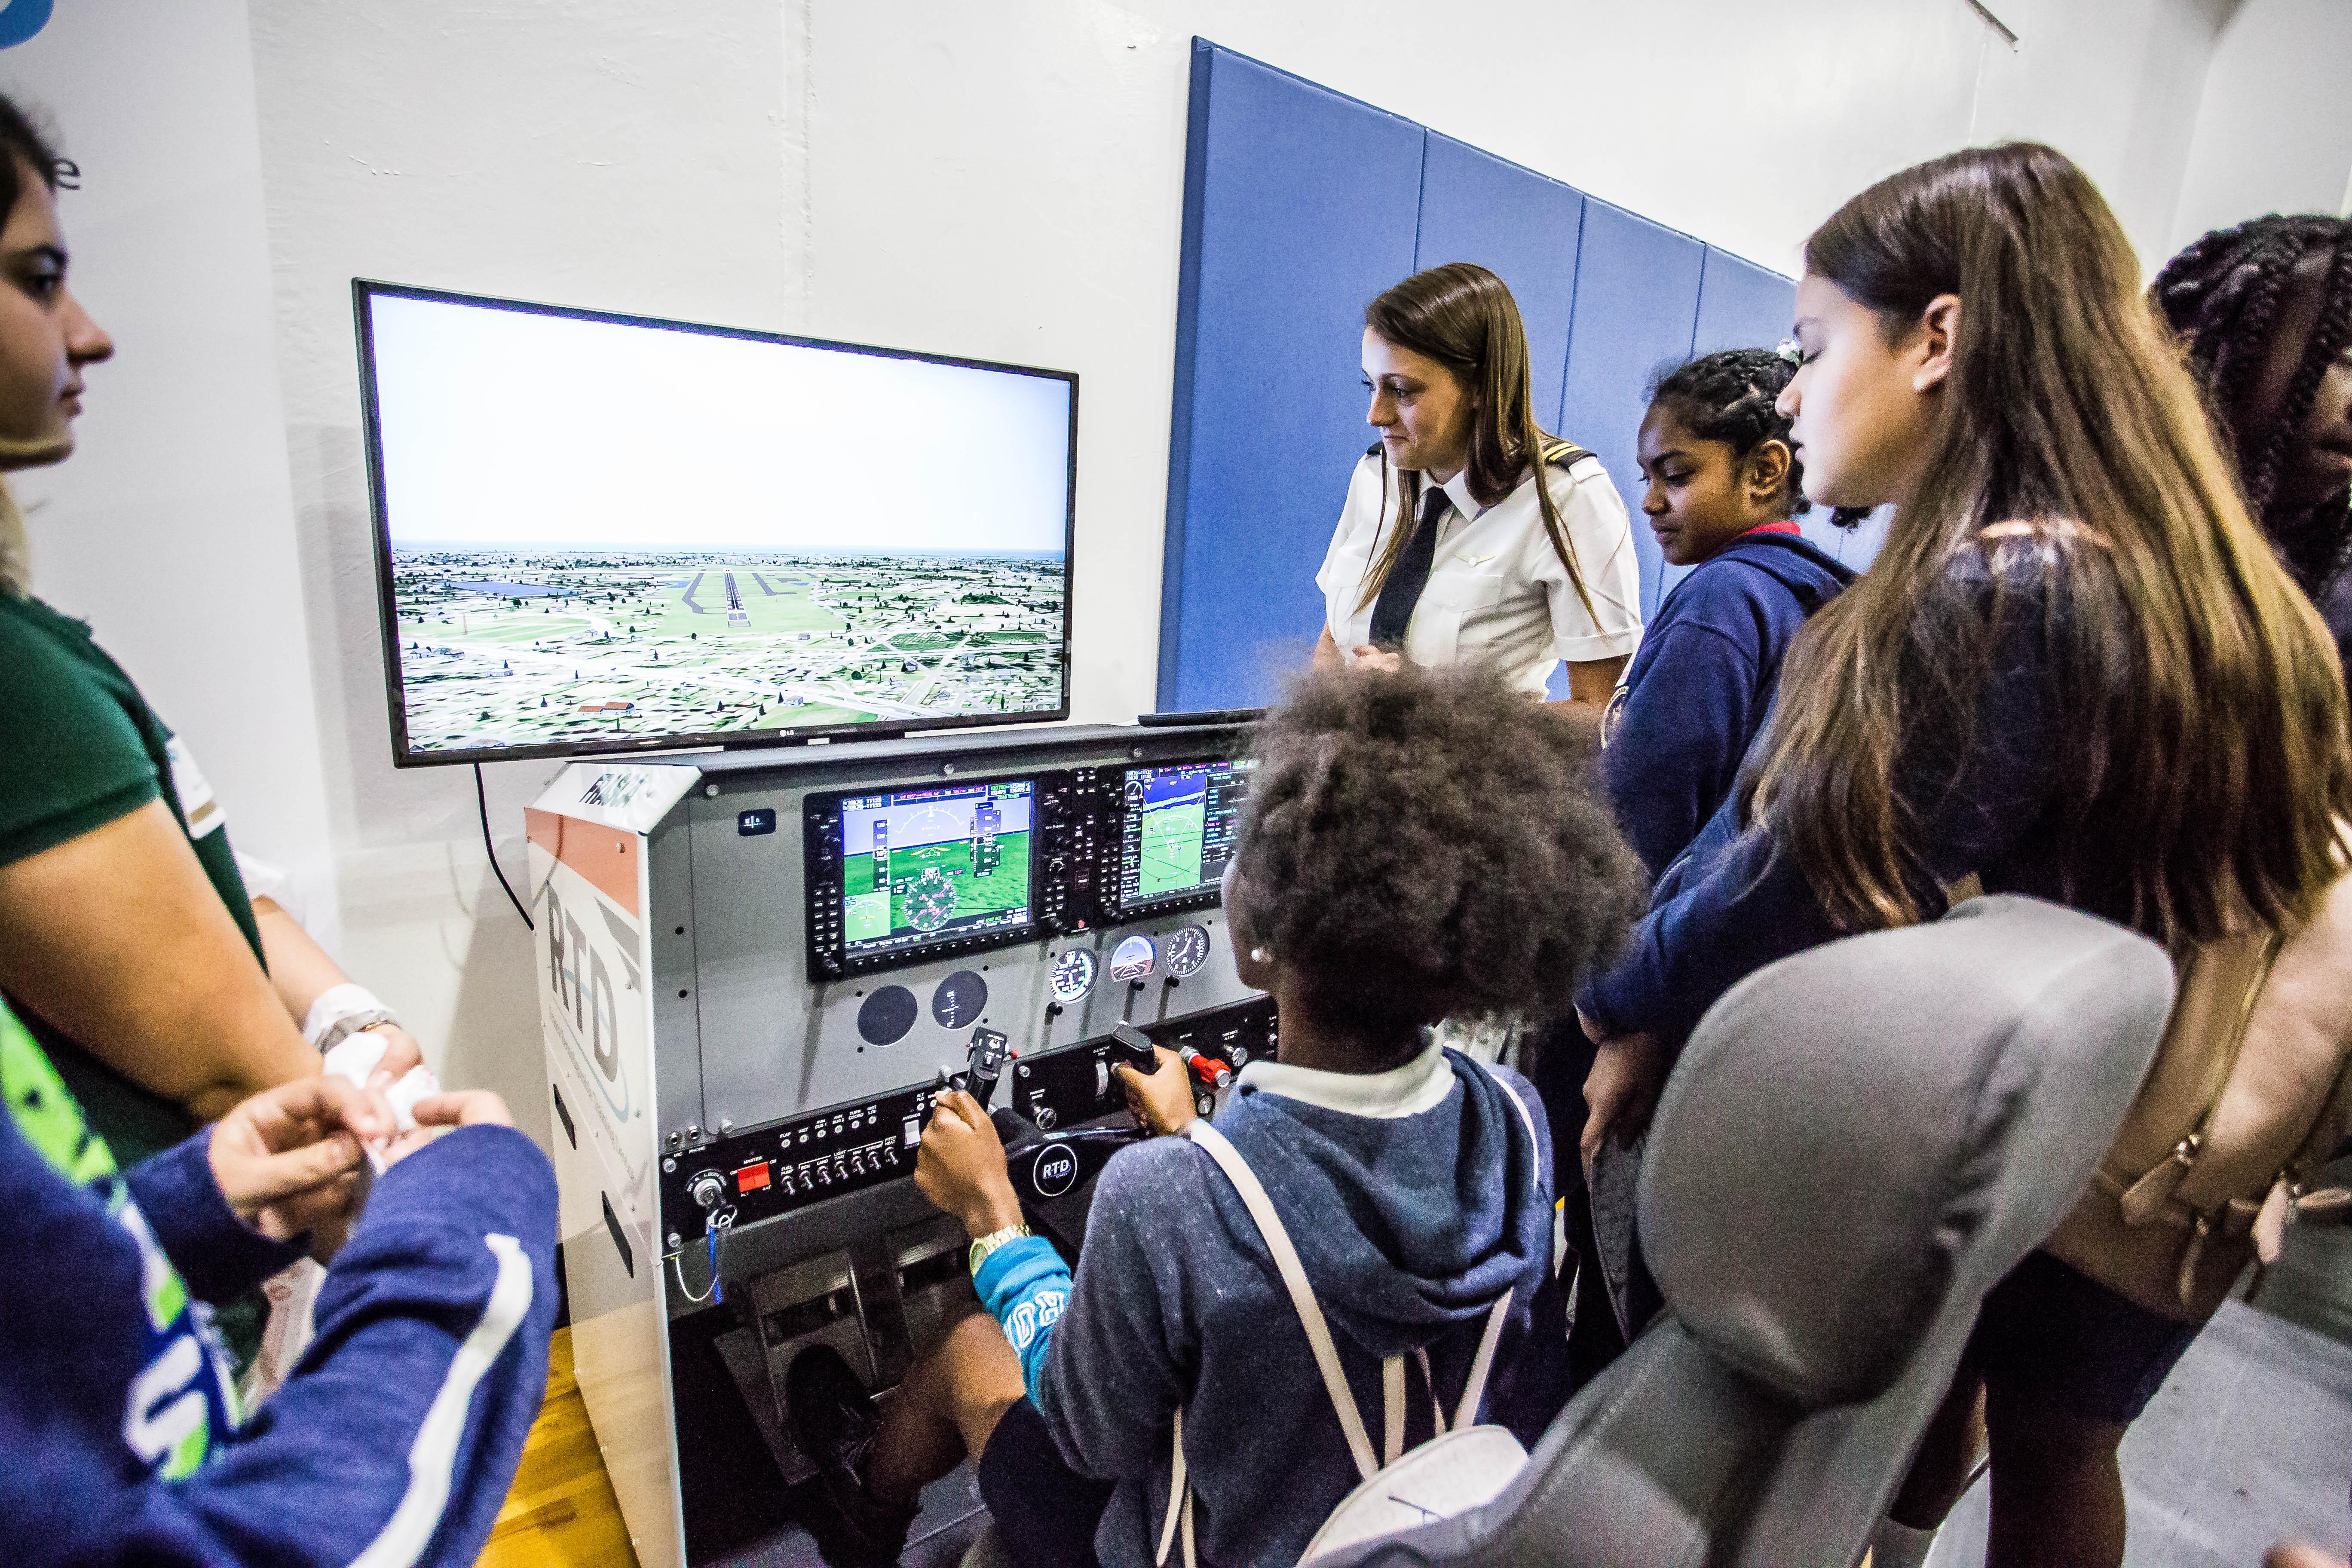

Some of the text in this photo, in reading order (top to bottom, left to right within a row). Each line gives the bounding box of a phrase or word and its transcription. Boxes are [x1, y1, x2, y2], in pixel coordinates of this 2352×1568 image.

[547, 879, 619, 1082] RTD
[744, 1156, 762, 1164] MASTER
[1043, 1160, 1069, 1178] RTD
